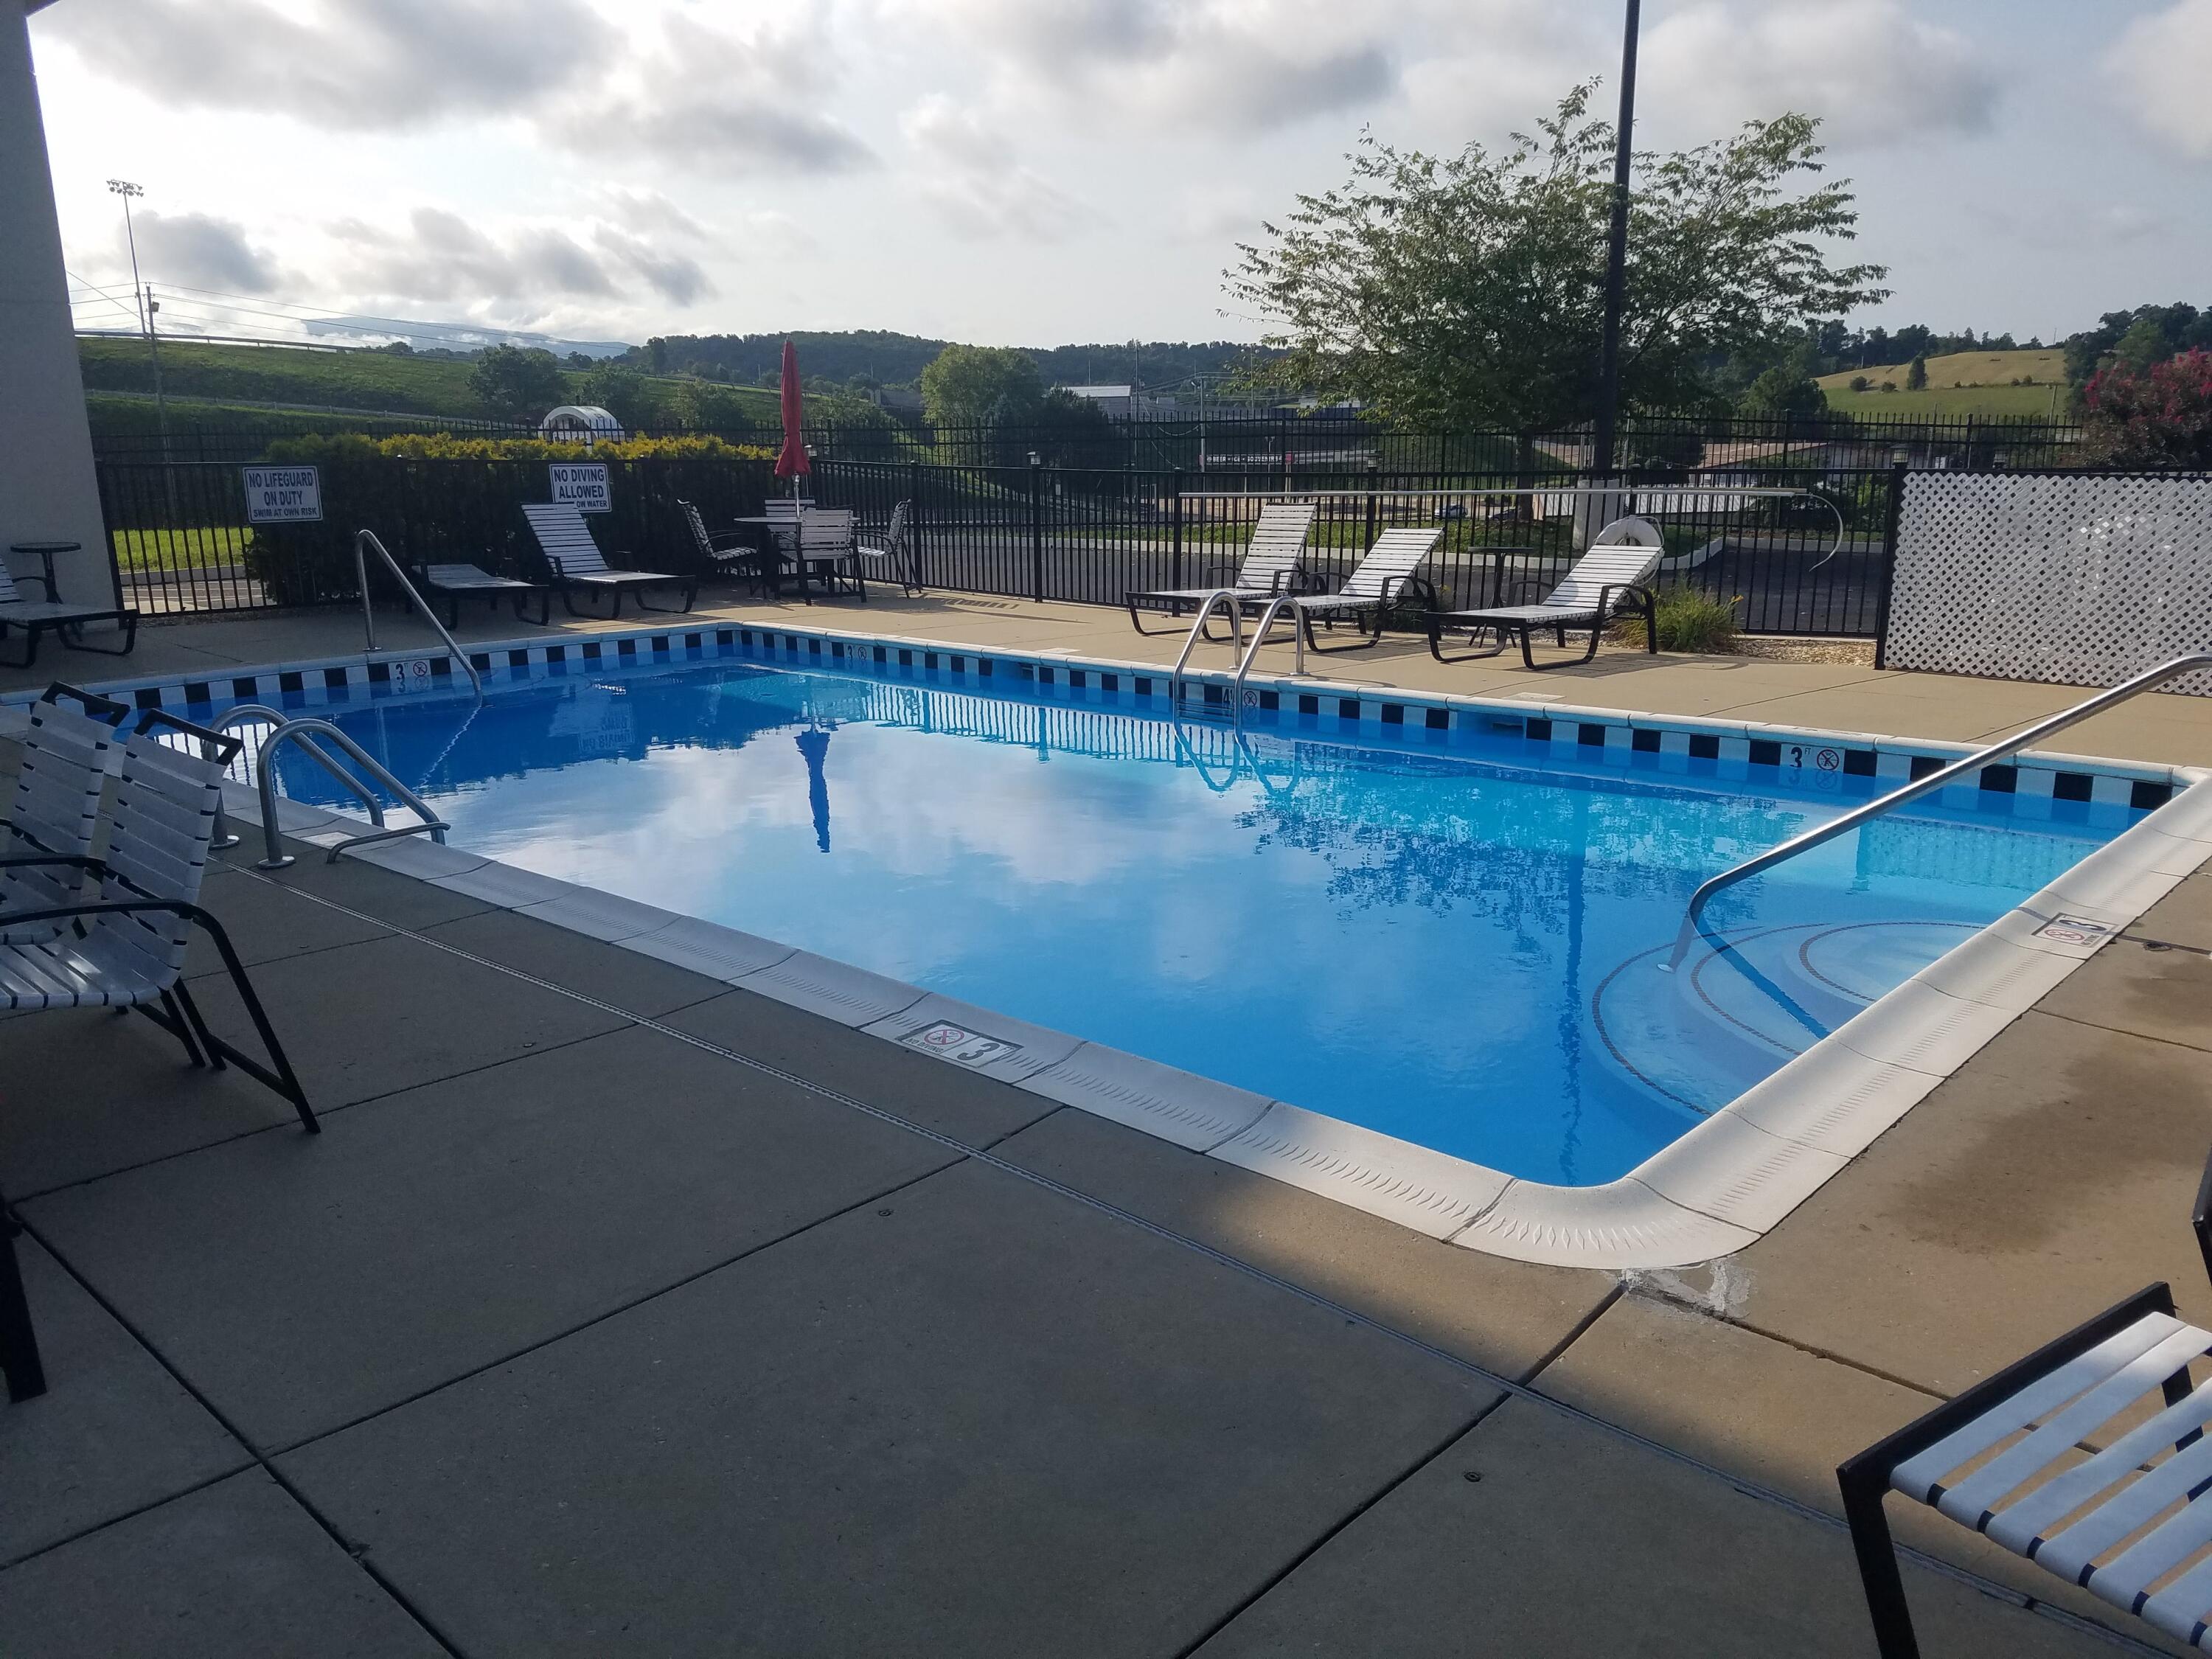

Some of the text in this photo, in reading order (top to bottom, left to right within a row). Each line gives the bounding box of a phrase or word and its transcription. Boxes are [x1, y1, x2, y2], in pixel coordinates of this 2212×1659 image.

[248, 472, 313, 487] NO LIFEGUARD
[554, 468, 605, 482] NO DIVING
[264, 490, 303, 507] ON DUTY
[559, 485, 604, 498] ALLOWED
[587, 500, 608, 508] WATER
[253, 507, 318, 518] SWIM AT OWN RISK
[396, 664, 406, 681] 3
[1790, 746, 1812, 768] 3 FT
[917, 1041, 945, 1053] DIVING
[956, 1042, 1001, 1060] 3
